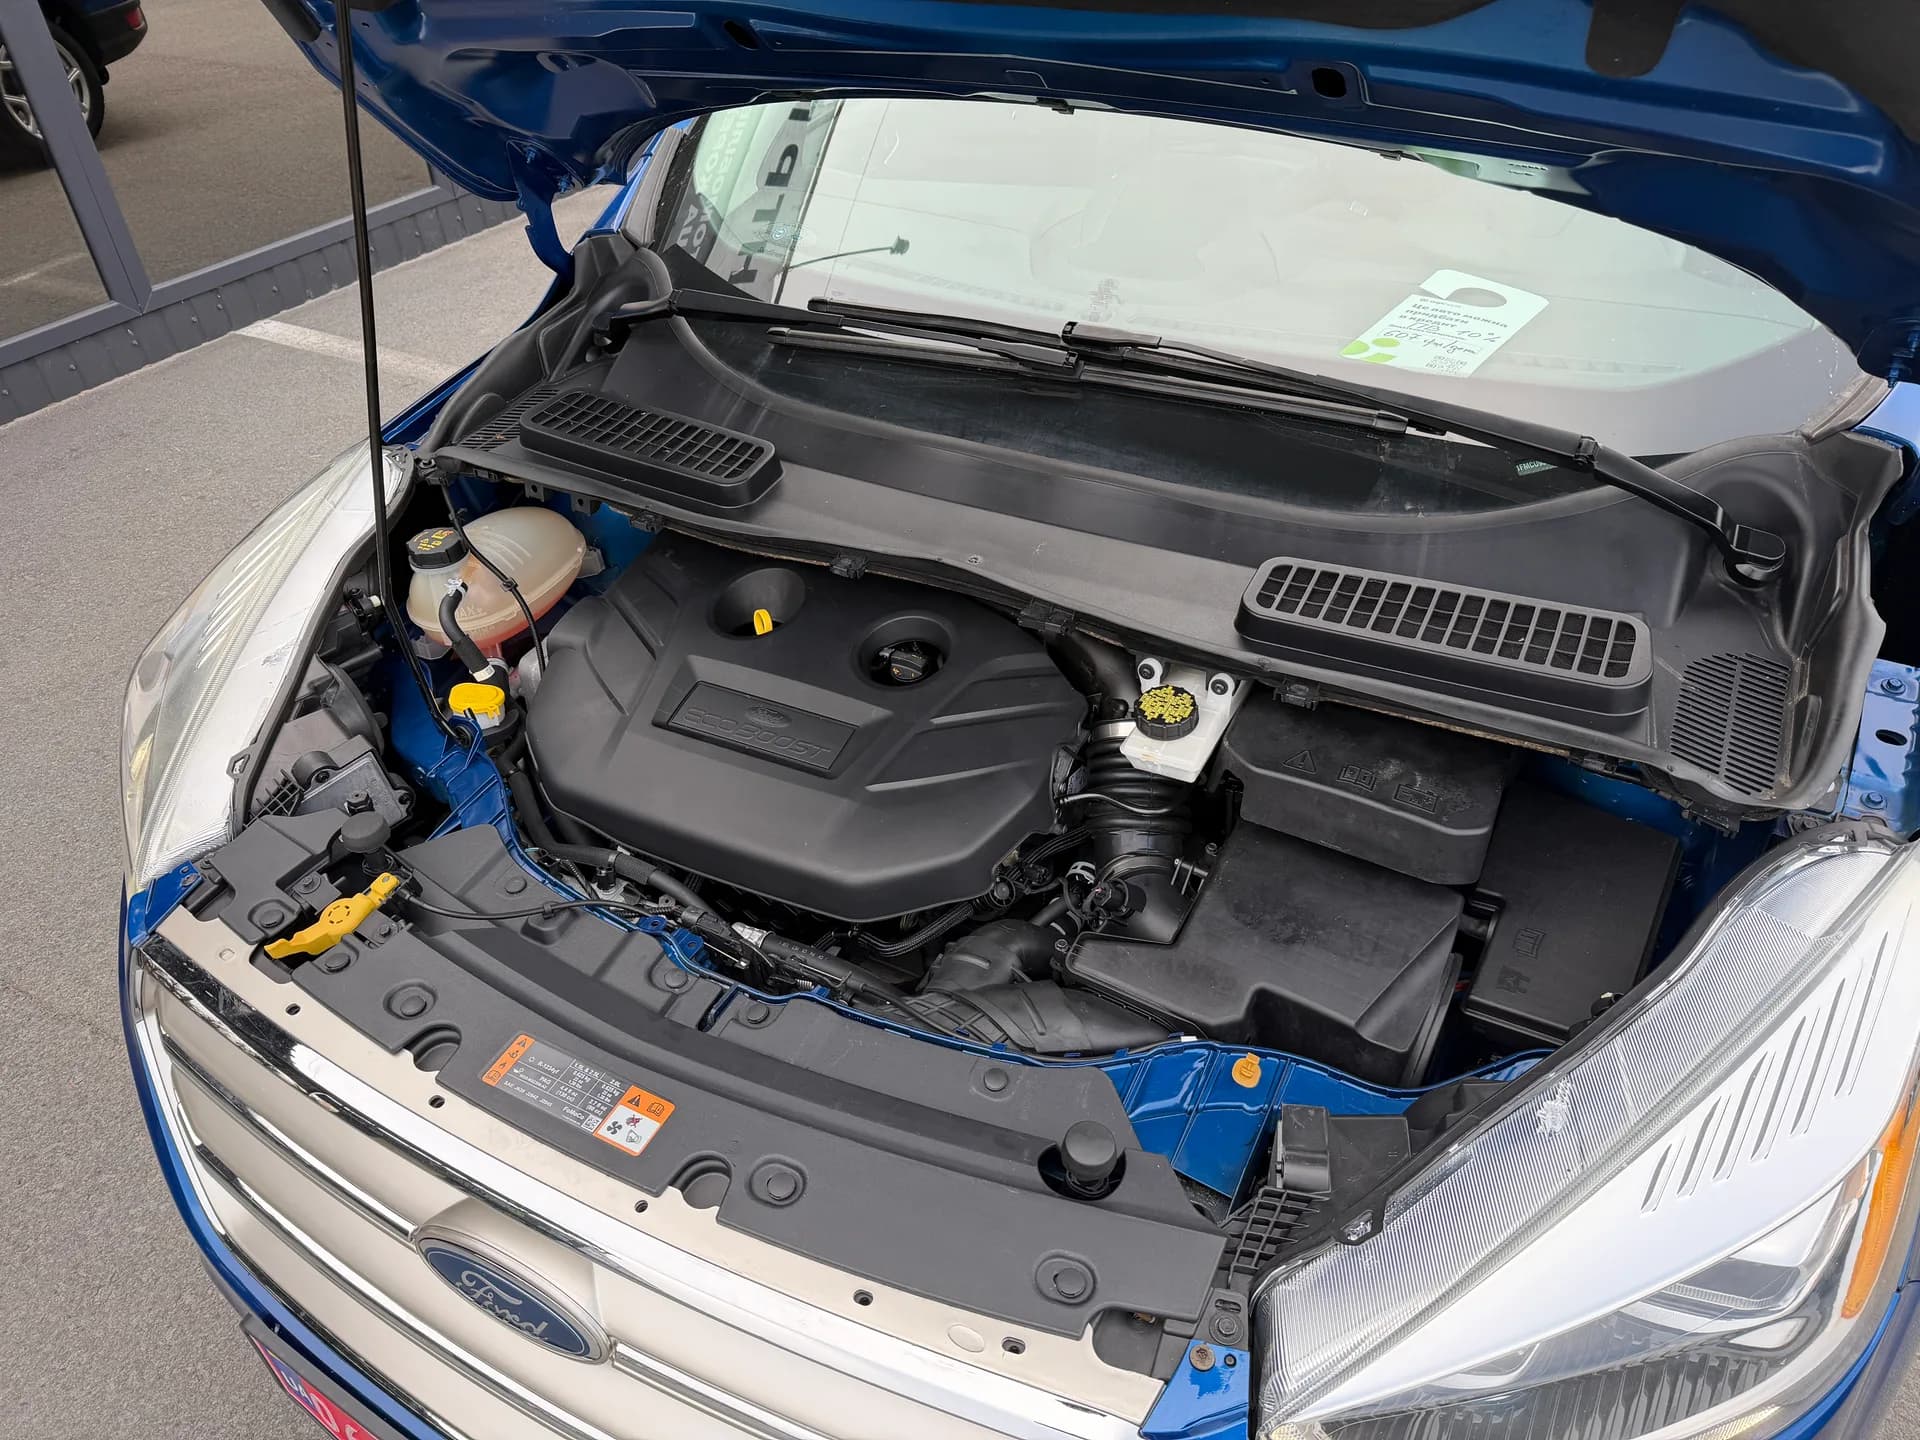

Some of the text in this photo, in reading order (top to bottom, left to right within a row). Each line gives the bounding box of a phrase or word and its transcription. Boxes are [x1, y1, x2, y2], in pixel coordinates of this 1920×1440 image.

[1405, 309, 1469, 324] придбати
[1462, 314, 1508, 328] можна
[684, 707, 833, 759] ECOBOOST
[562, 1106, 585, 1120] FoMoCo
[455, 1270, 549, 1341] Ford
